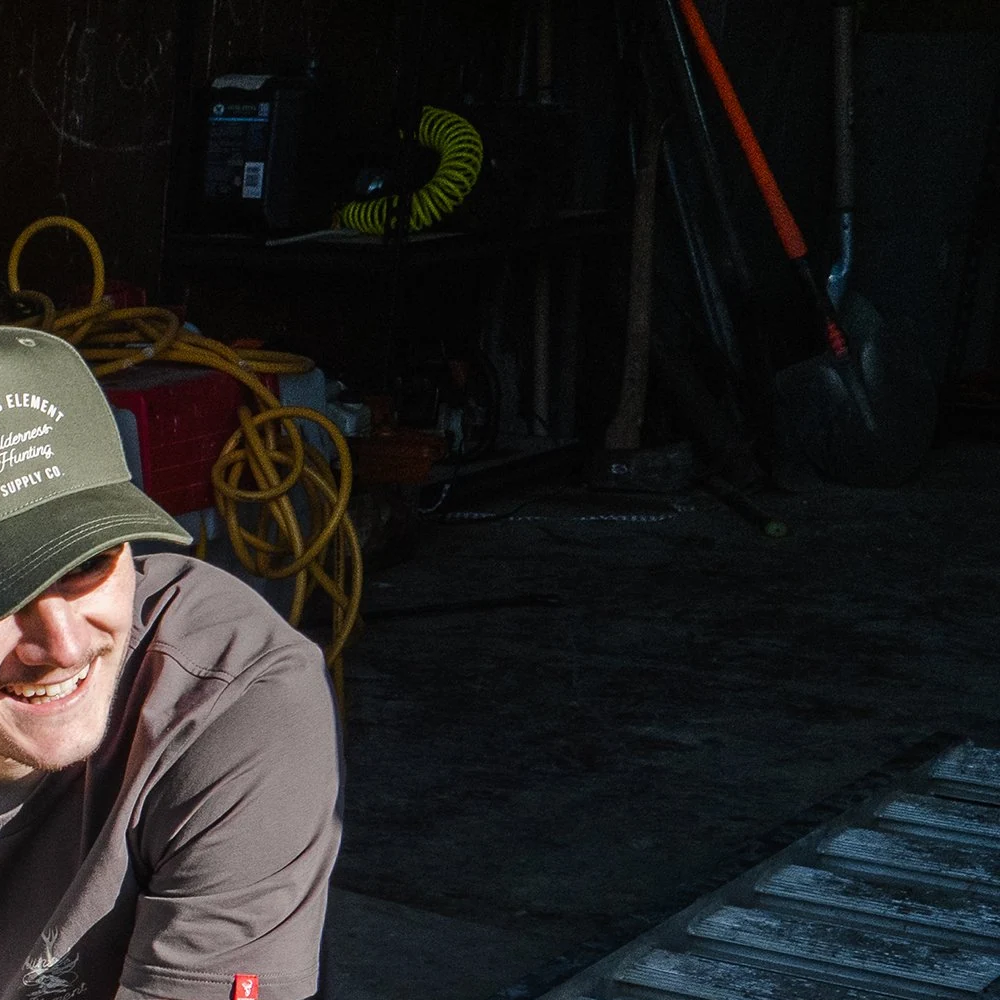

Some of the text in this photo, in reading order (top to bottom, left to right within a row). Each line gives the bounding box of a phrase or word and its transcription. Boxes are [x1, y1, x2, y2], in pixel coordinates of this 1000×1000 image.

[5, 393, 64, 422] ELEMENT
[0, 465, 65, 497] SUPPLY CO.
